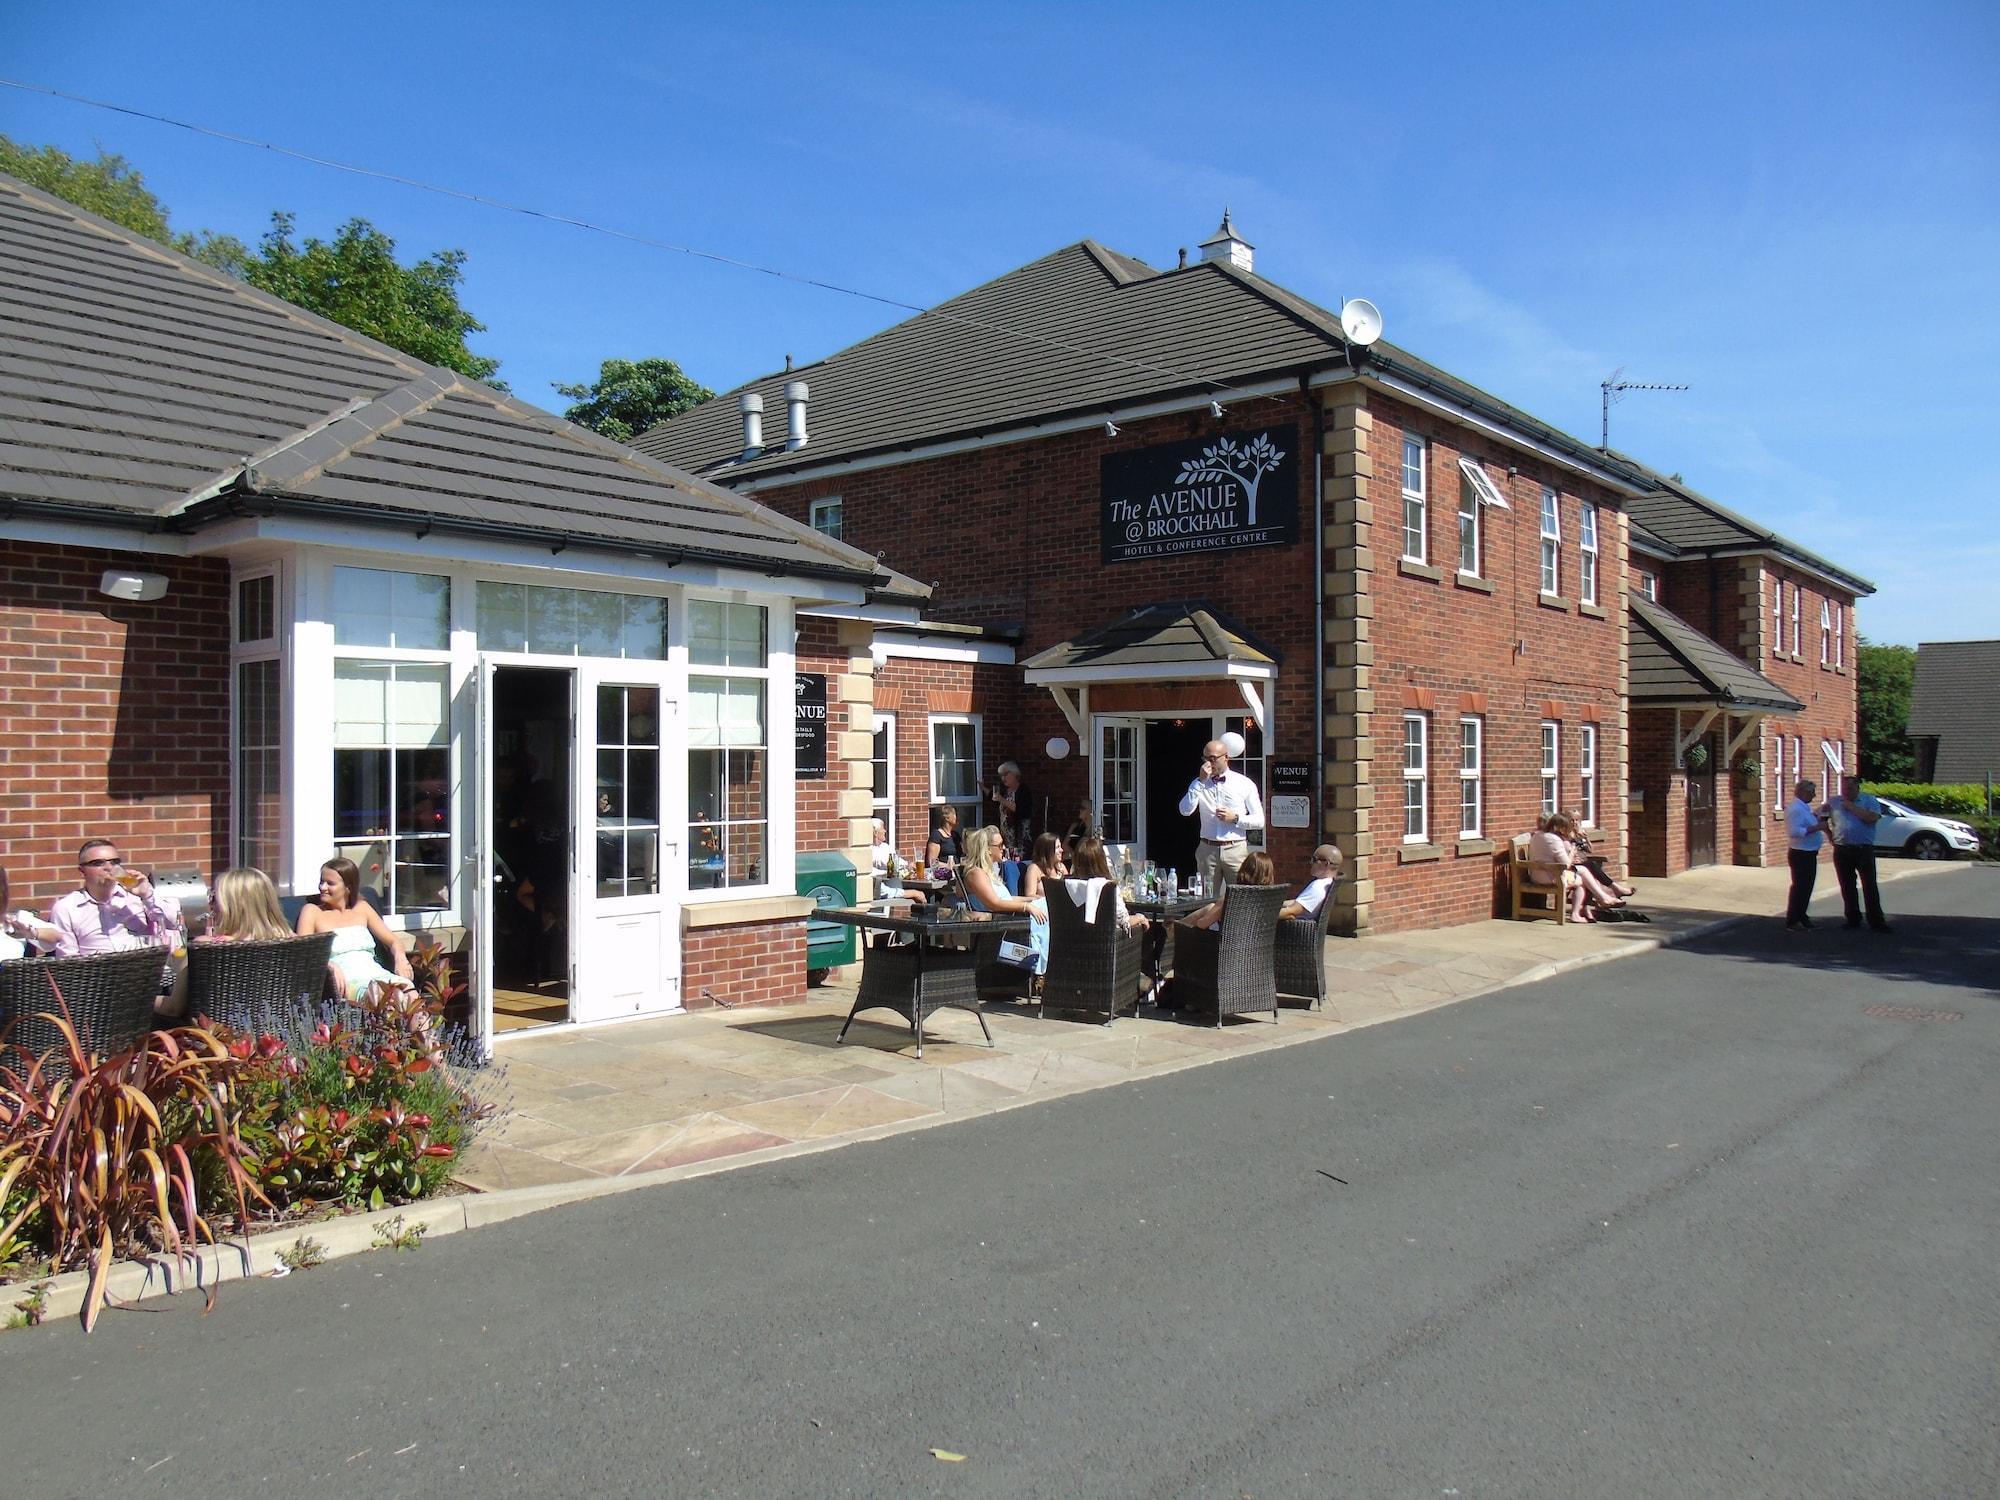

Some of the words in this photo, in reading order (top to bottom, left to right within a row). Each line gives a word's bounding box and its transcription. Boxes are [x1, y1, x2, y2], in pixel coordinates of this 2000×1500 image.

[1110, 499, 1142, 523] The
[1146, 483, 1237, 517] AVENUE
[1125, 521, 1144, 542] @
[1147, 511, 1238, 537] BROCKHALL
[1124, 543, 1153, 557] HOTEL
[1156, 543, 1163, 552] &
[1166, 536, 1226, 552] CONFERENCE
[1230, 531, 1268, 545] CENTRE
